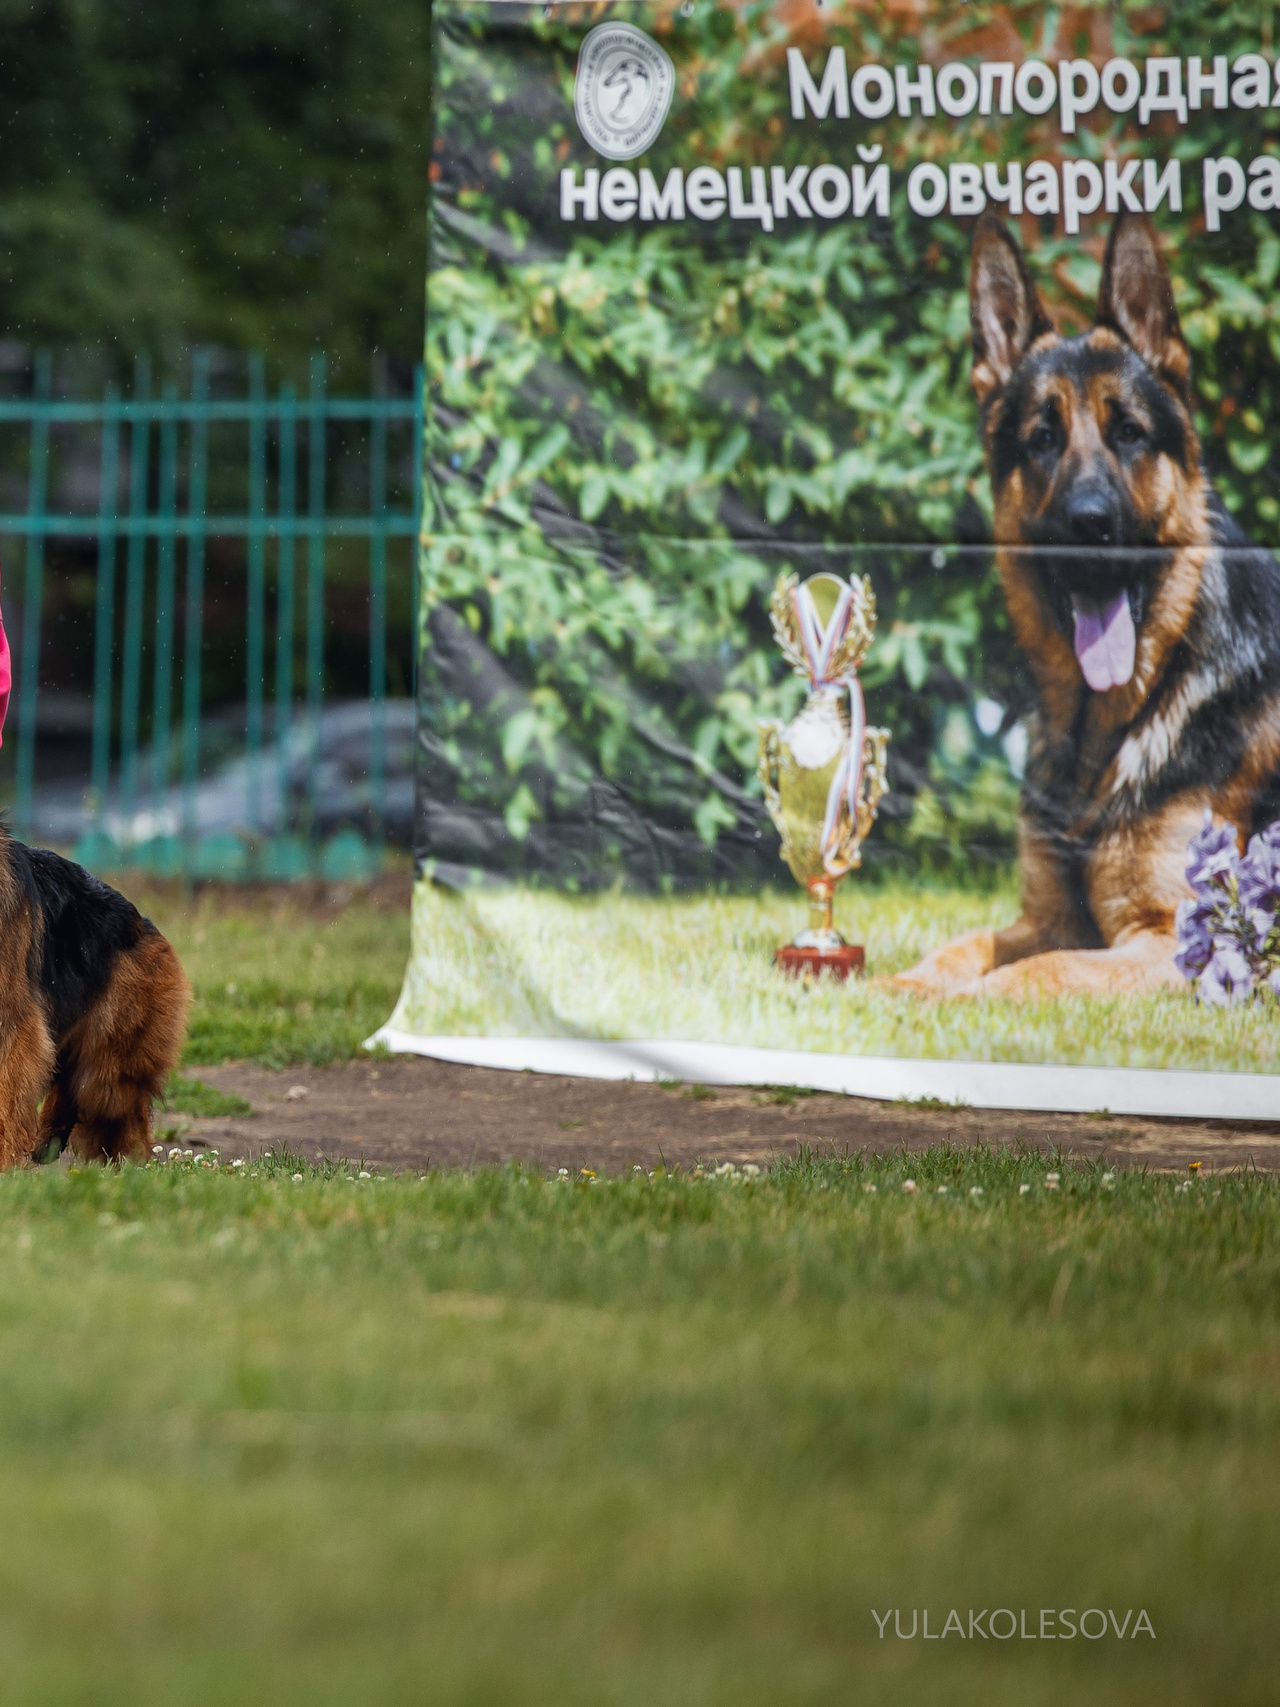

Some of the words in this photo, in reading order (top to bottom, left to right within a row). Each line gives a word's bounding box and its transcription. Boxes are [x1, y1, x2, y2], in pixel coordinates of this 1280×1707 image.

[787, 46, 1280, 134] Монопородна
[559, 144, 890, 232] немецкой
[907, 157, 1183, 234] овчарки
